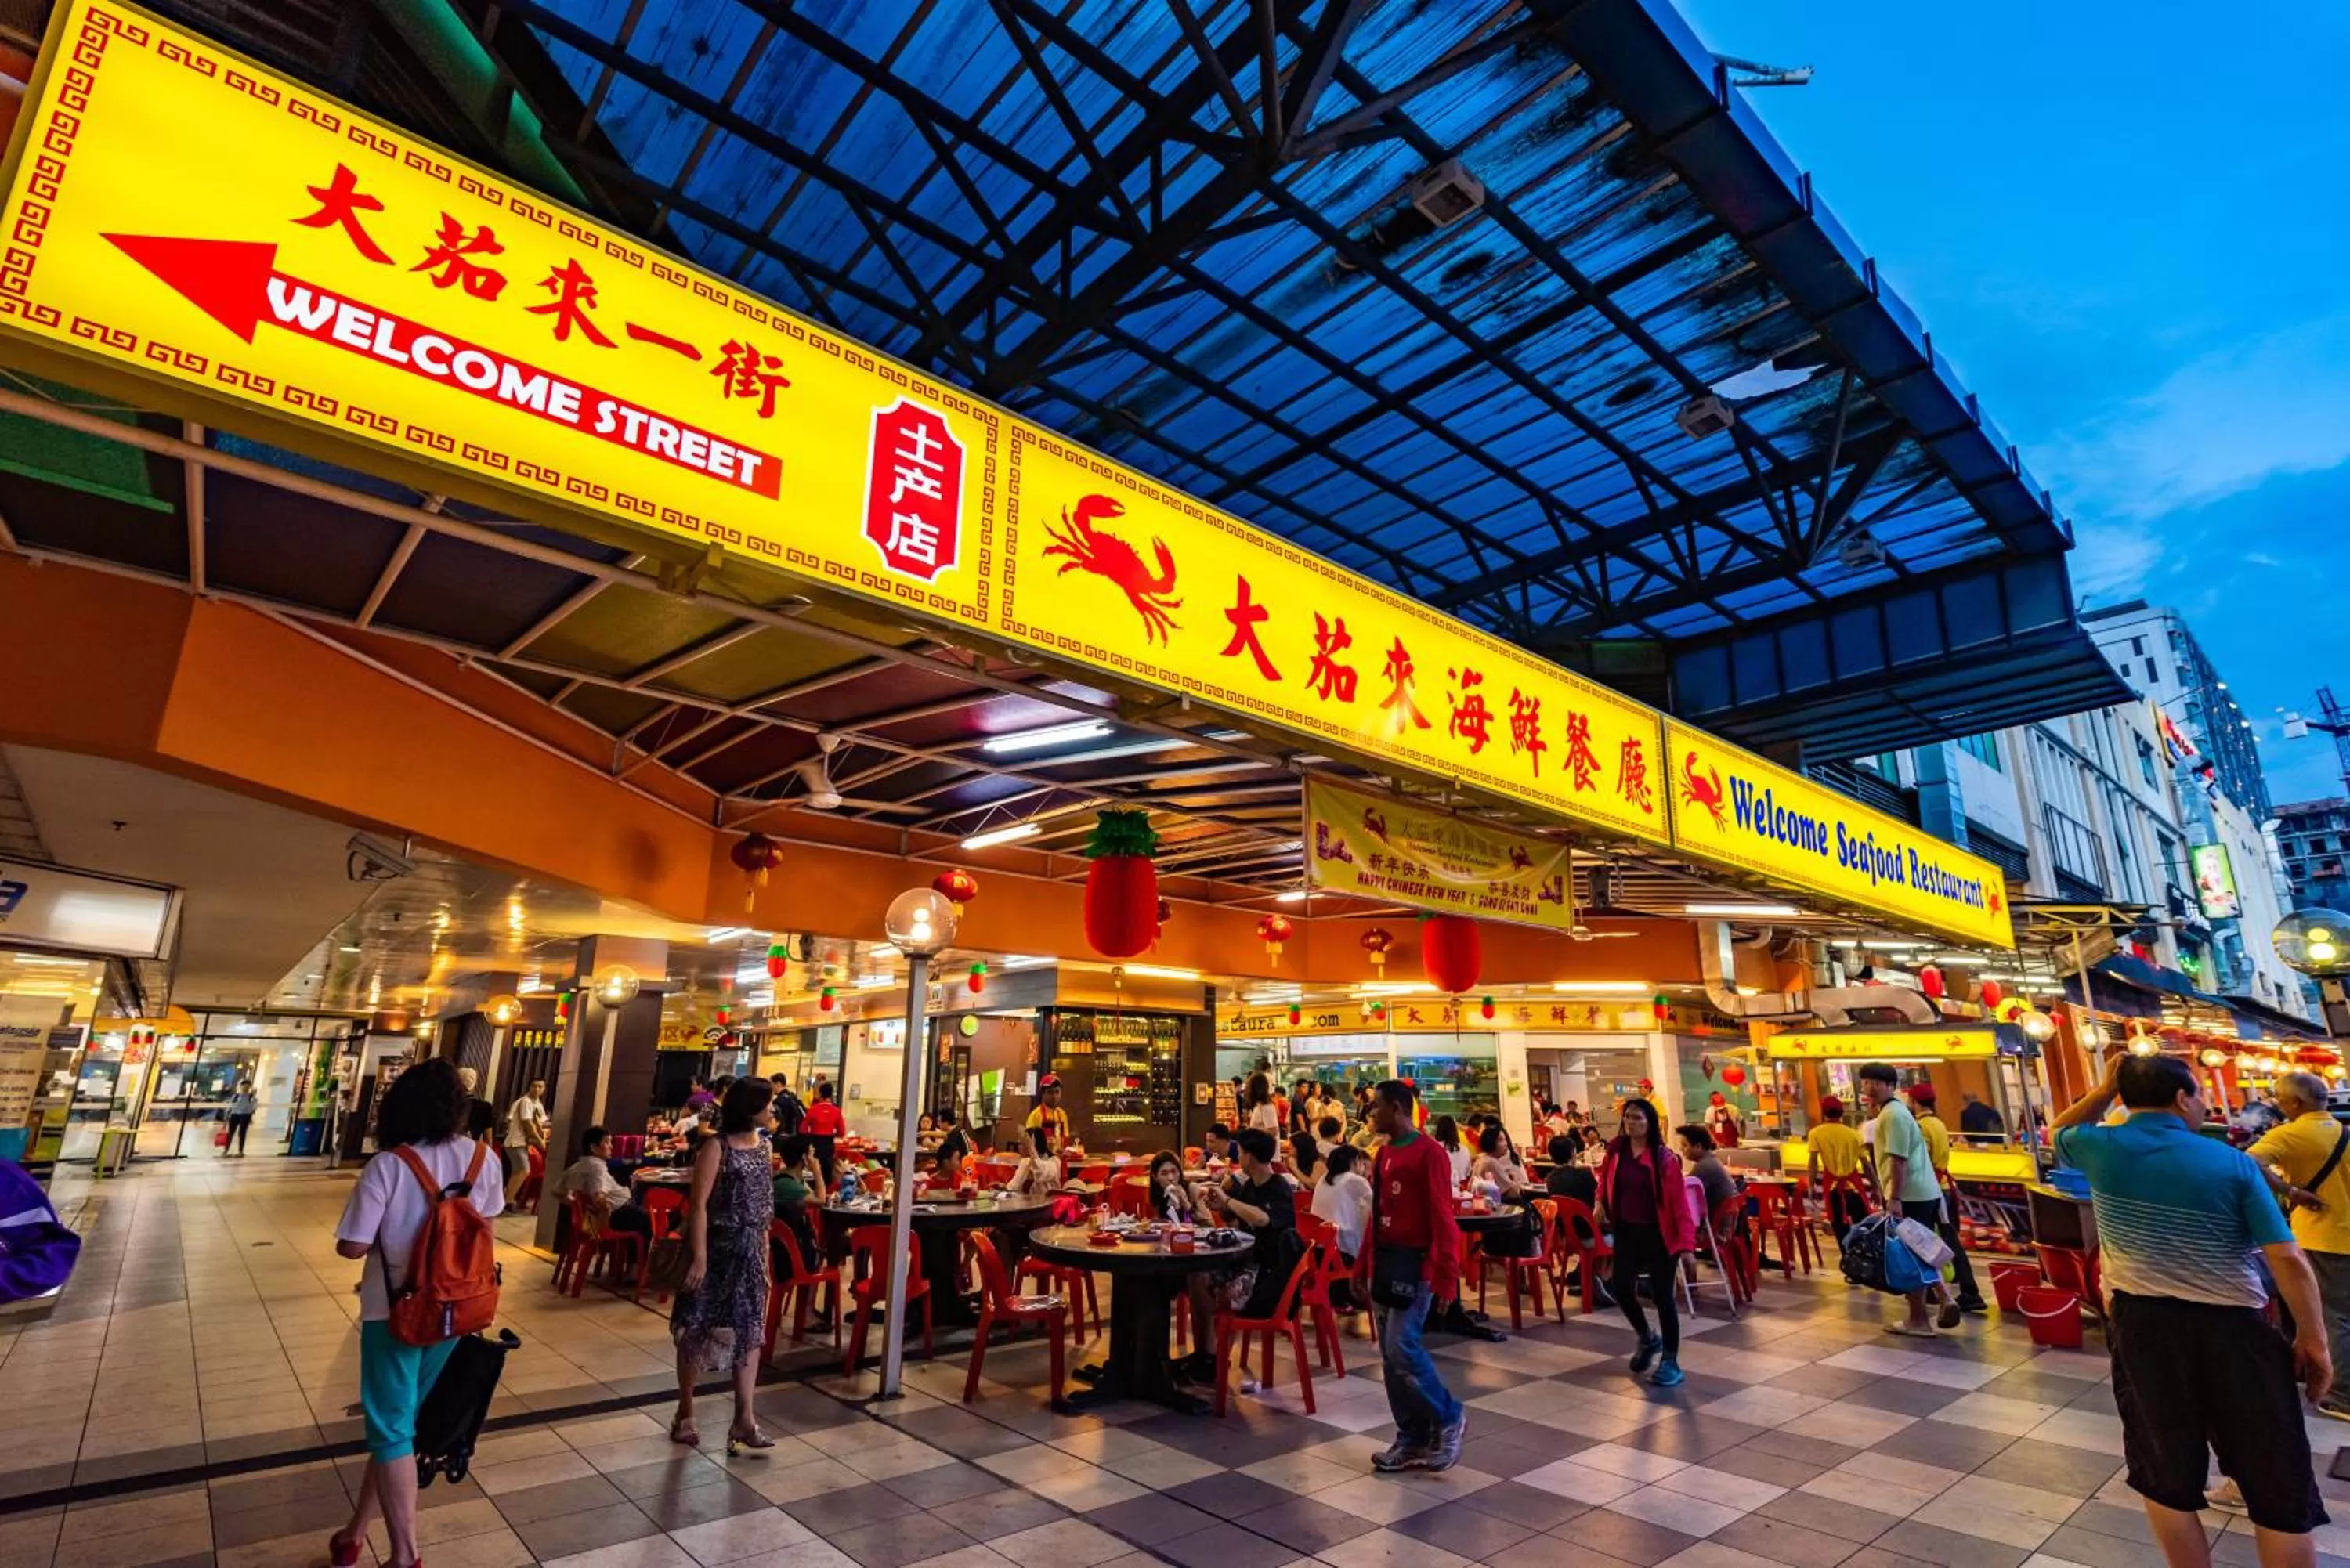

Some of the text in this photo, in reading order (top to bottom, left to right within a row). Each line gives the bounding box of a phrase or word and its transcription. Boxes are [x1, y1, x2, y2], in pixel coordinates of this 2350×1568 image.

[288, 162, 791, 419] 大茄來一街
[266, 276, 762, 486] WELCOME STREET
[885, 423, 944, 566] 土产店
[1219, 573, 1653, 815] 大茄來海鮮餐廳
[1358, 871, 1386, 890] HAPPY
[1387, 877, 1424, 897] CHINESE
[1425, 885, 1445, 900] NEW
[1447, 887, 1466, 903] YEAR
[1730, 775, 1983, 909] Welcome Seafood Restaurant
